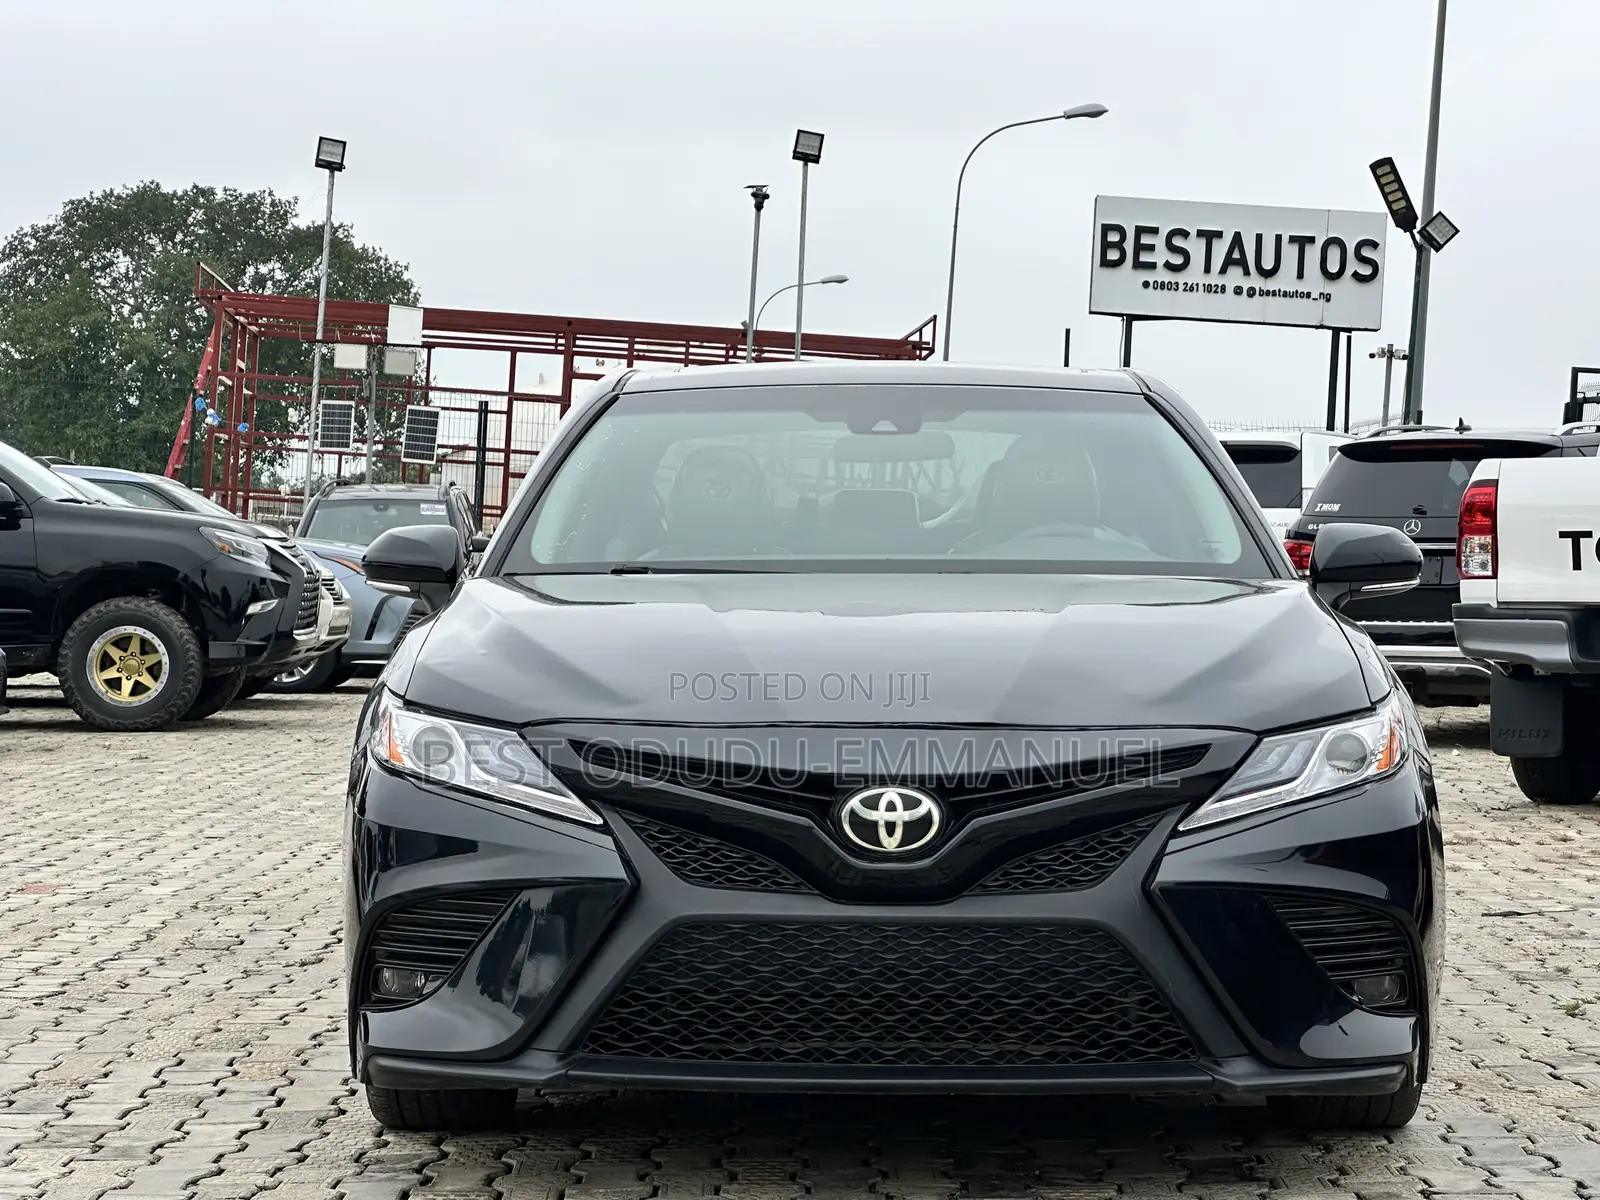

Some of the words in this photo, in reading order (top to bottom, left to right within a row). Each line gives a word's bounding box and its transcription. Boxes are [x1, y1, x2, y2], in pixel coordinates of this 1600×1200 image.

[1099, 222, 1380, 284] BESTAUTOS
[1152, 280, 1179, 291] 0803
[1183, 282, 1199, 292] 261
[1202, 283, 1227, 294] 1028
[1558, 530, 1600, 571] T
[1498, 728, 1552, 740] HILUX
